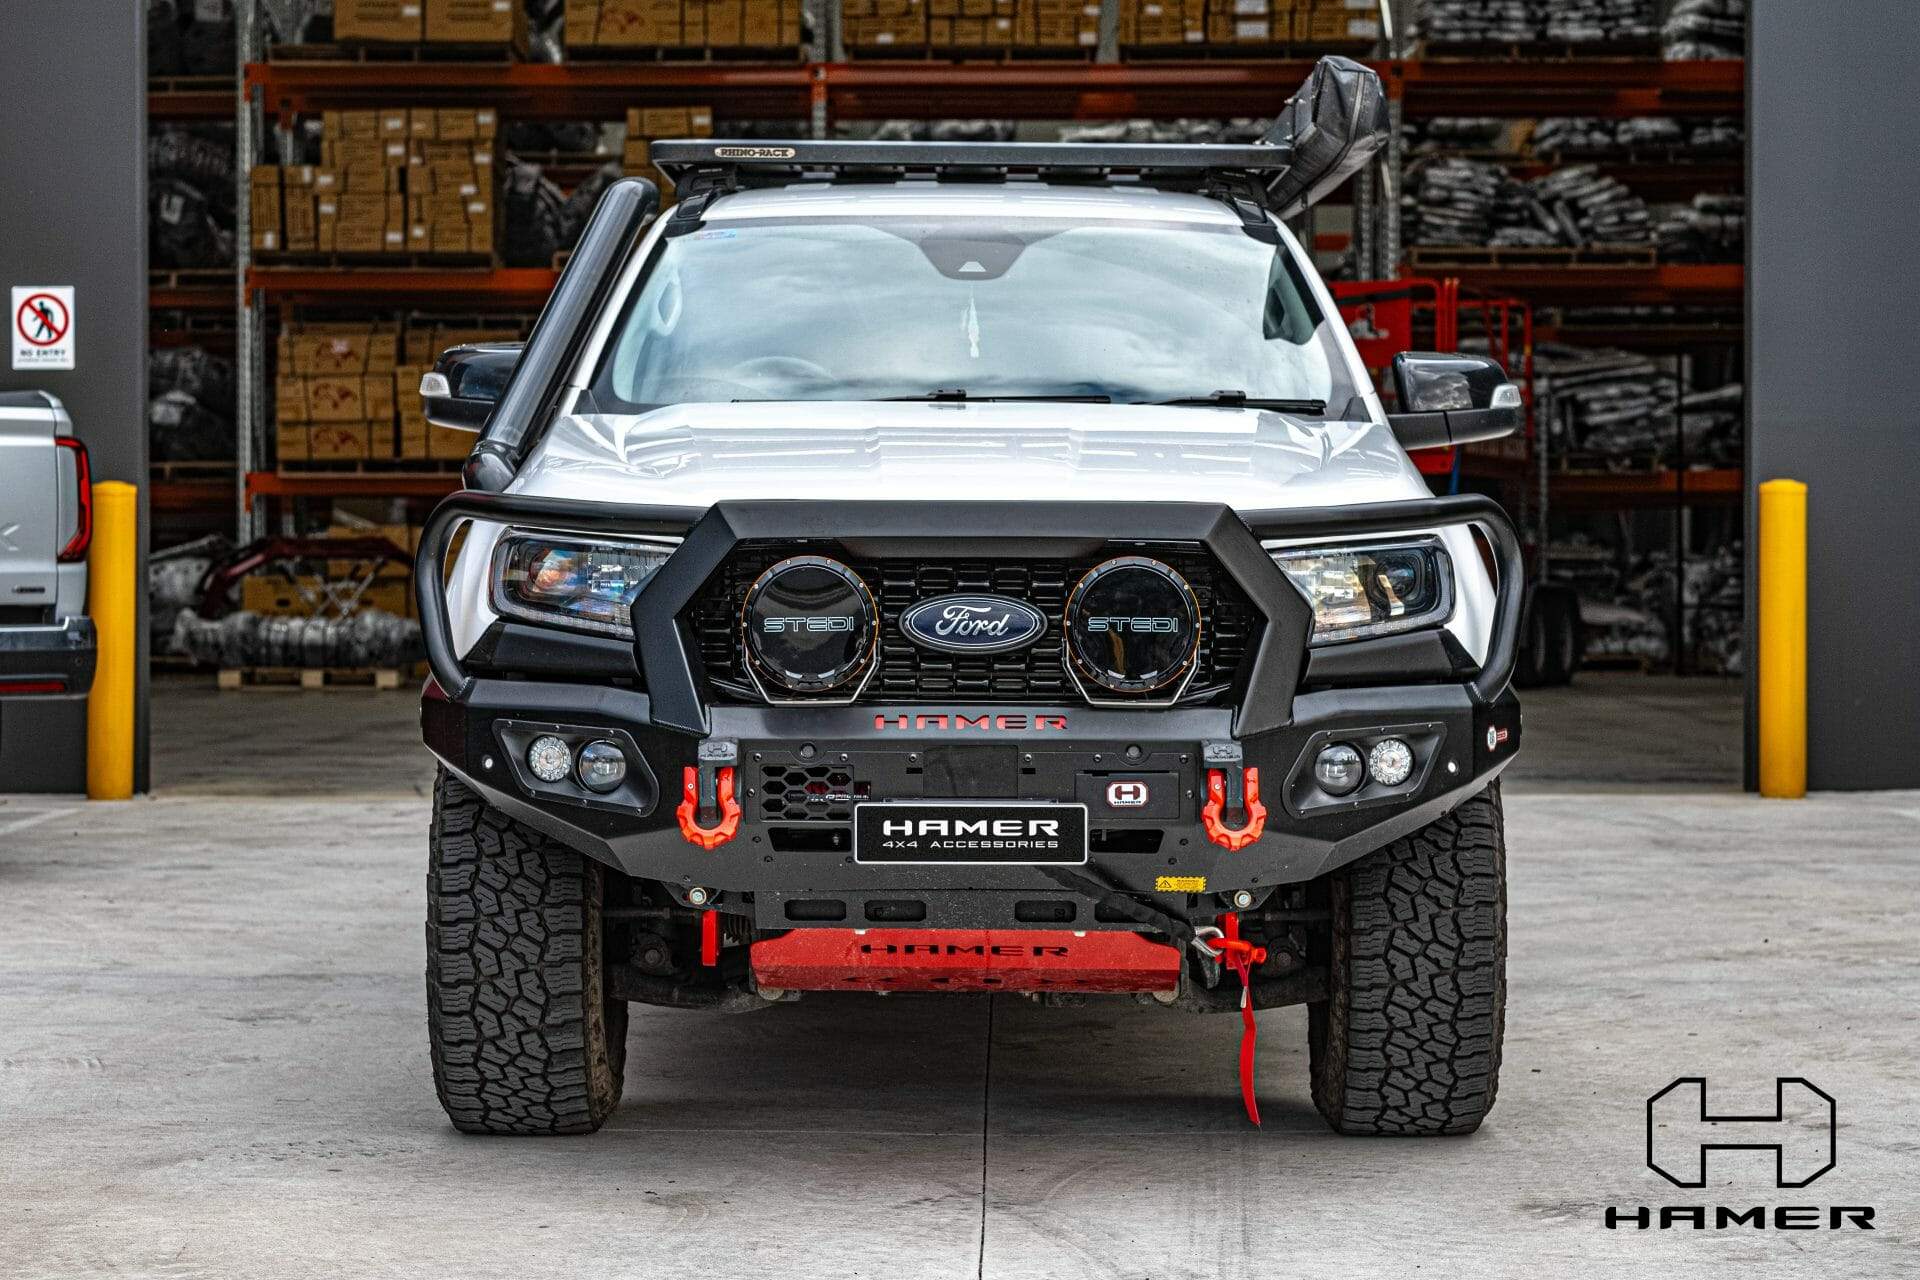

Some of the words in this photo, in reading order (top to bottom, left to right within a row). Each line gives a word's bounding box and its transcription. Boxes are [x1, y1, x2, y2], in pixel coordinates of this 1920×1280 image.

[720, 148, 789, 157] RHINO-RACK
[763, 616, 854, 633] STEDI
[935, 604, 1009, 637] Ford
[1087, 616, 1179, 633] STEDI
[874, 714, 1068, 730] HAMER
[883, 819, 1059, 837] HAMER
[930, 840, 1059, 849] ACCESSORIES
[861, 944, 1069, 958] HAMER
